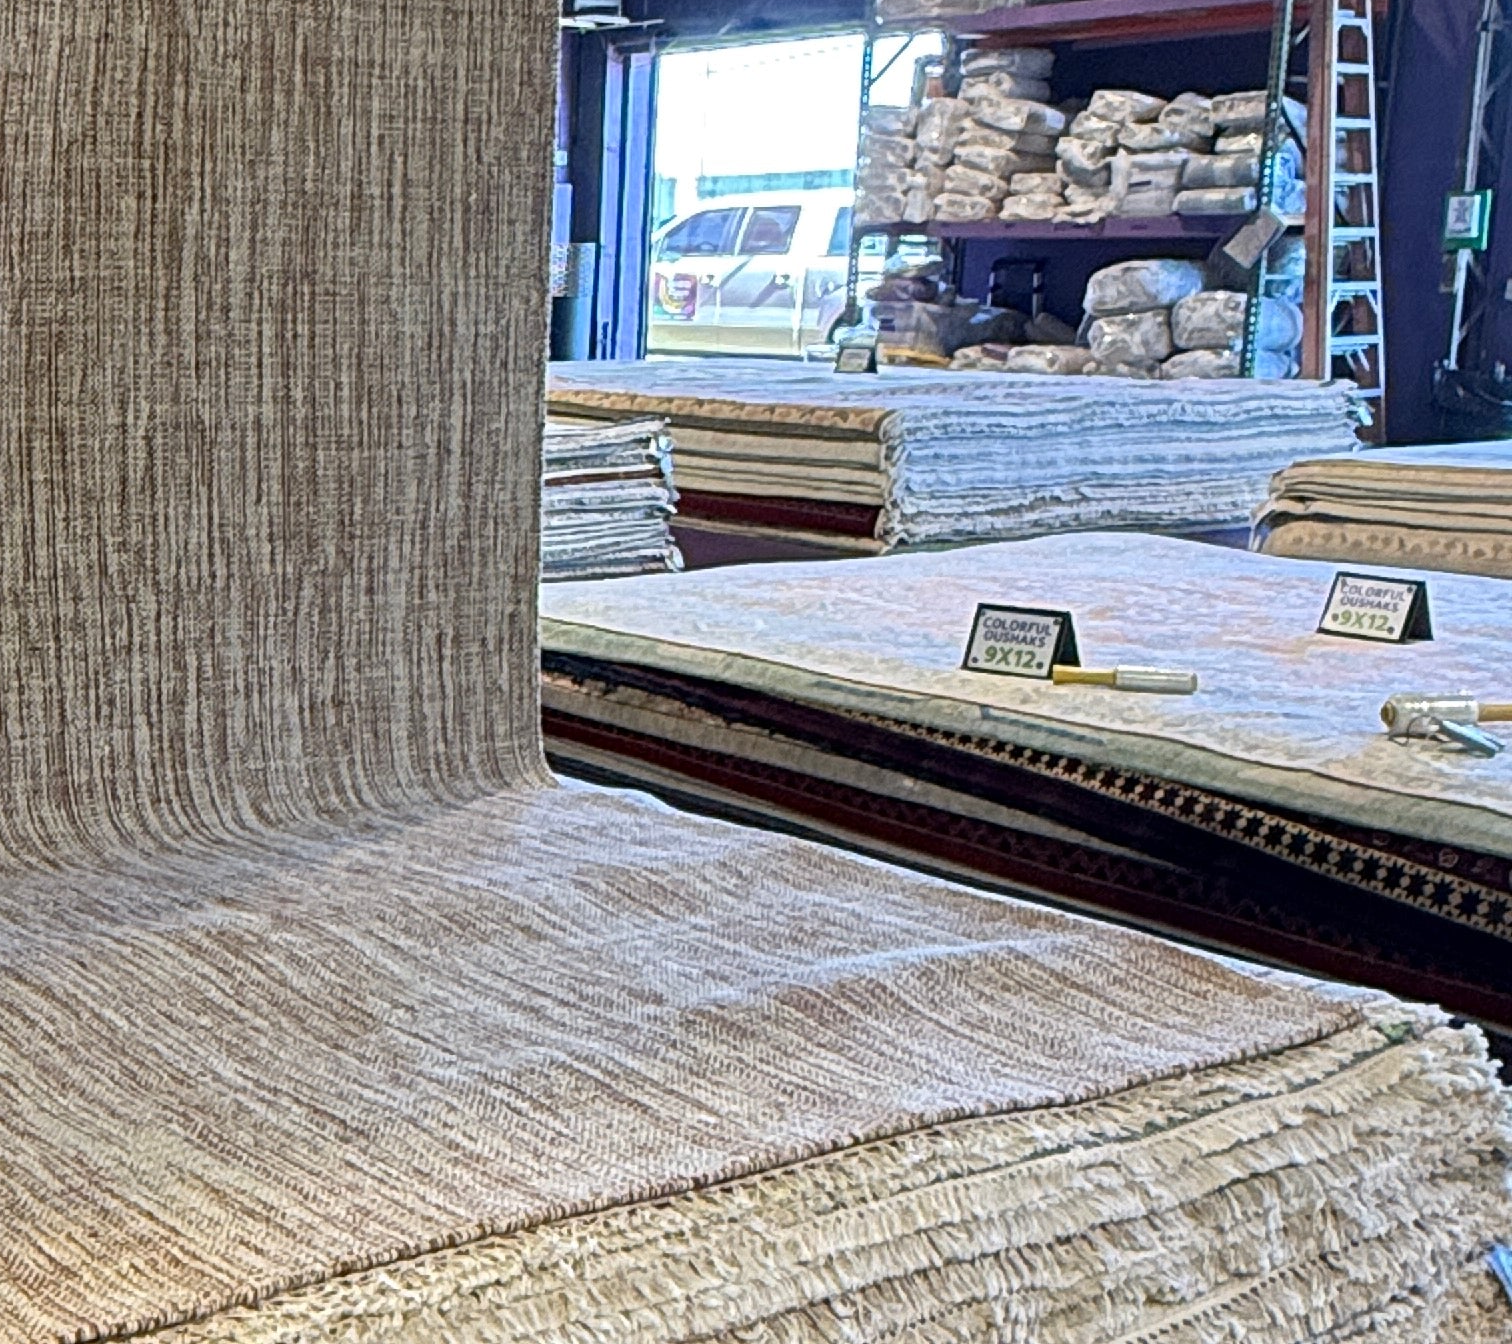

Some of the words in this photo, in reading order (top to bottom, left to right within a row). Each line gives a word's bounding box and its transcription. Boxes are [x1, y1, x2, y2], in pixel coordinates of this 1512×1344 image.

[1340, 584, 1406, 602] COLORFUL
[983, 616, 1052, 636] COLORFUL
[1338, 609, 1390, 632] 9X12
[984, 645, 1037, 669] 9X12
